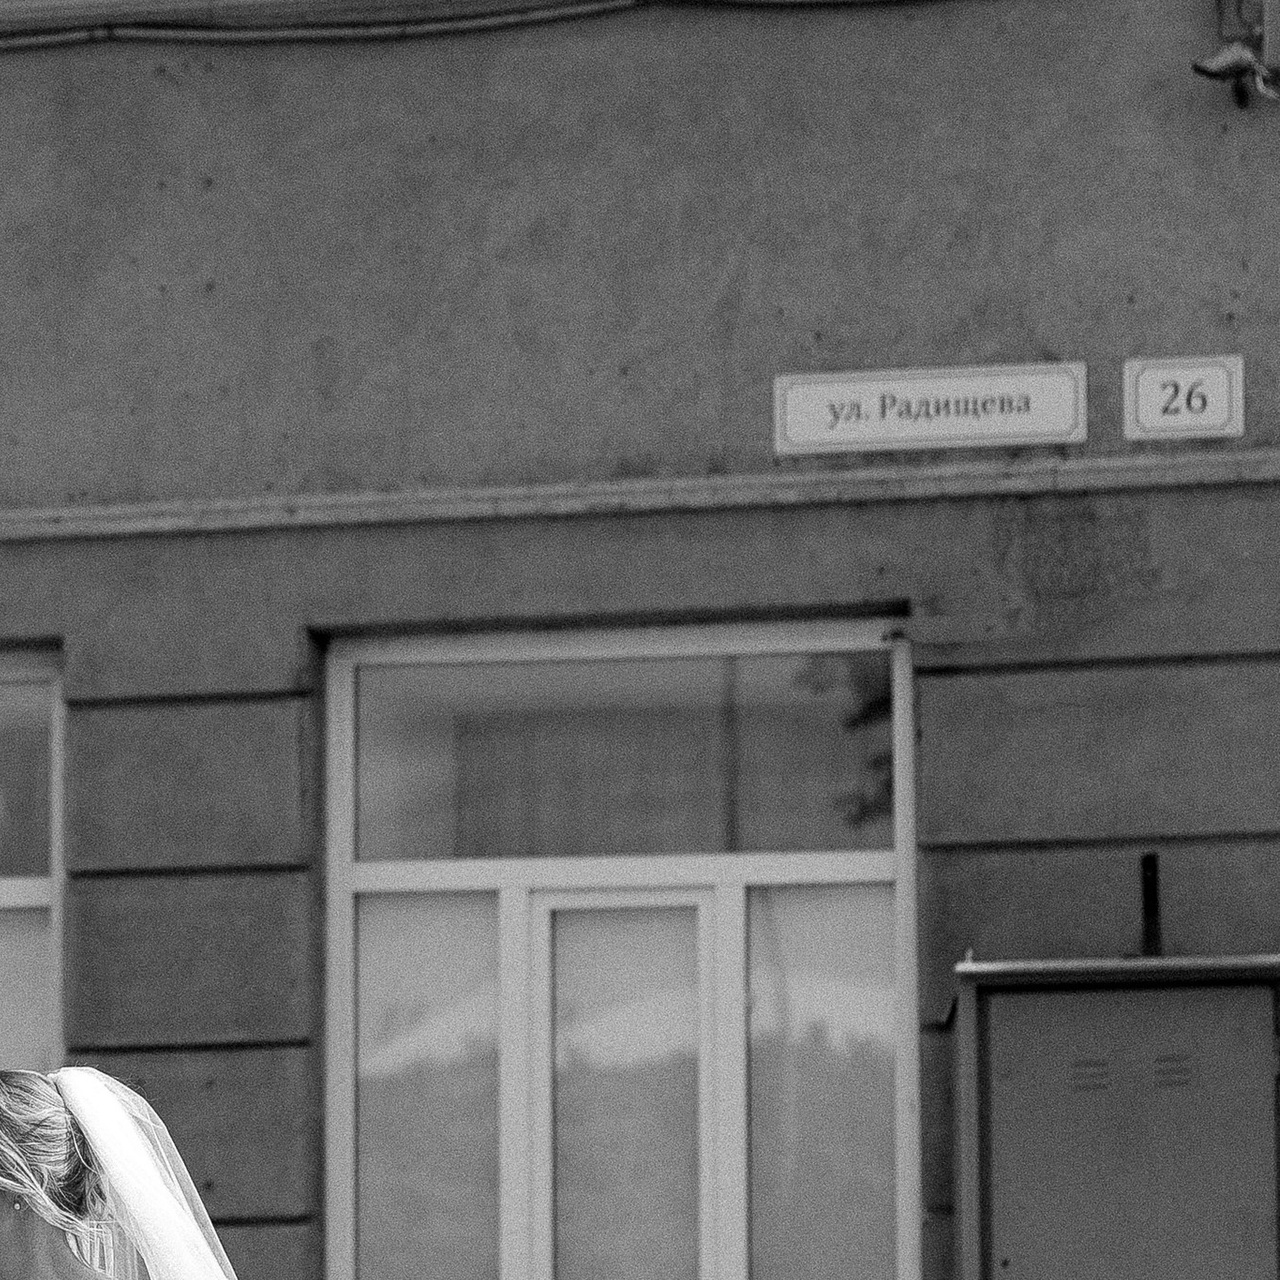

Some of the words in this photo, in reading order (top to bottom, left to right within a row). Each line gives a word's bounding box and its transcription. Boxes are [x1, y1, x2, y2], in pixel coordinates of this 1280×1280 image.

[826, 398, 869, 429] ул.
[879, 391, 1032, 421] Радищева
[1160, 379, 1208, 416] 26
